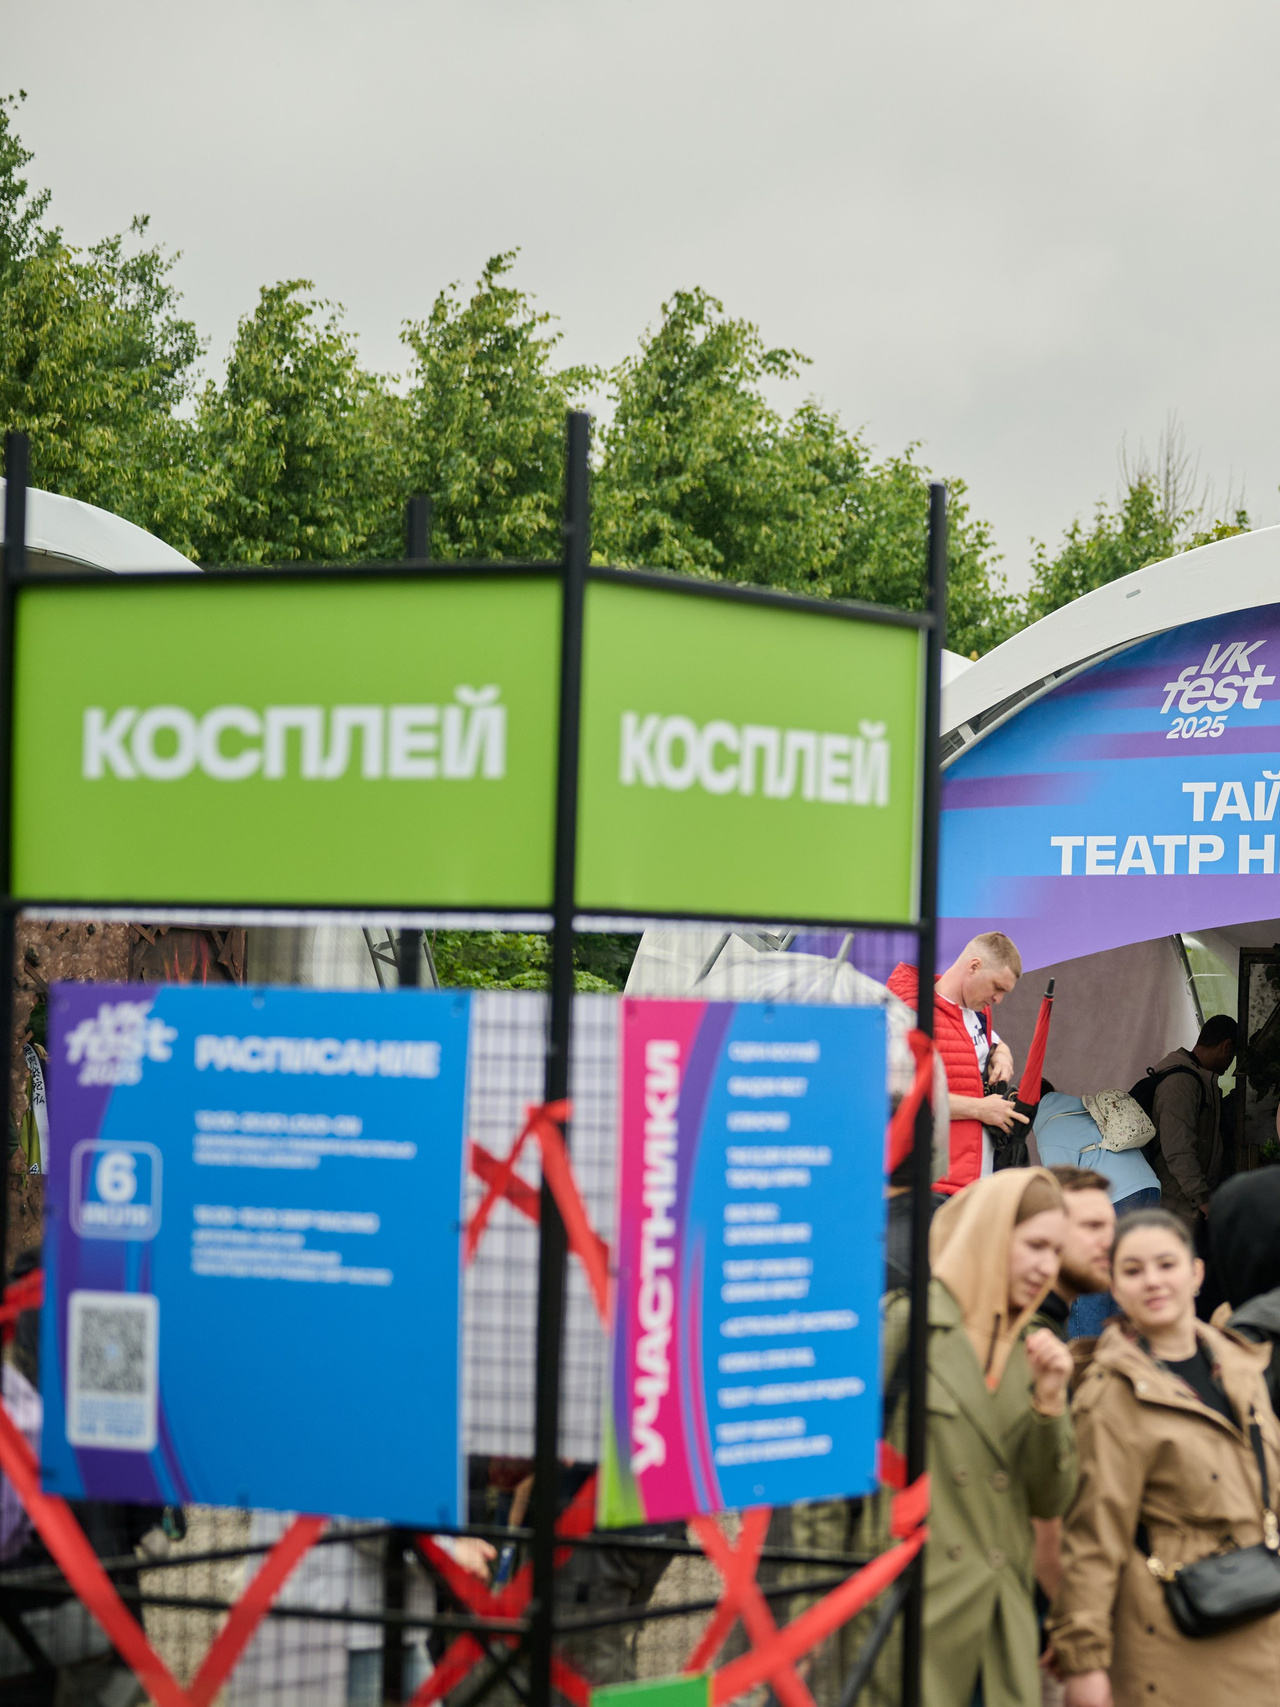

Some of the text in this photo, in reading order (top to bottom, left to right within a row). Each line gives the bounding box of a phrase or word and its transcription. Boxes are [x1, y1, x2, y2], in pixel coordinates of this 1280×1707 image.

[1200, 639, 1267, 675] VK
[1160, 664, 1277, 714] fest
[82, 684, 508, 782] КОСПЛЕЙ
[1165, 715, 1229, 740] 2025
[618, 709, 891, 808] КОСПЛЕЙ
[1050, 834, 1226, 876] ТЕАТР
[195, 1034, 441, 1079] РАСПИСАНИЕ
[96, 1151, 137, 1203] 6
[631, 1040, 680, 1474] УЧАСТНИКИ
